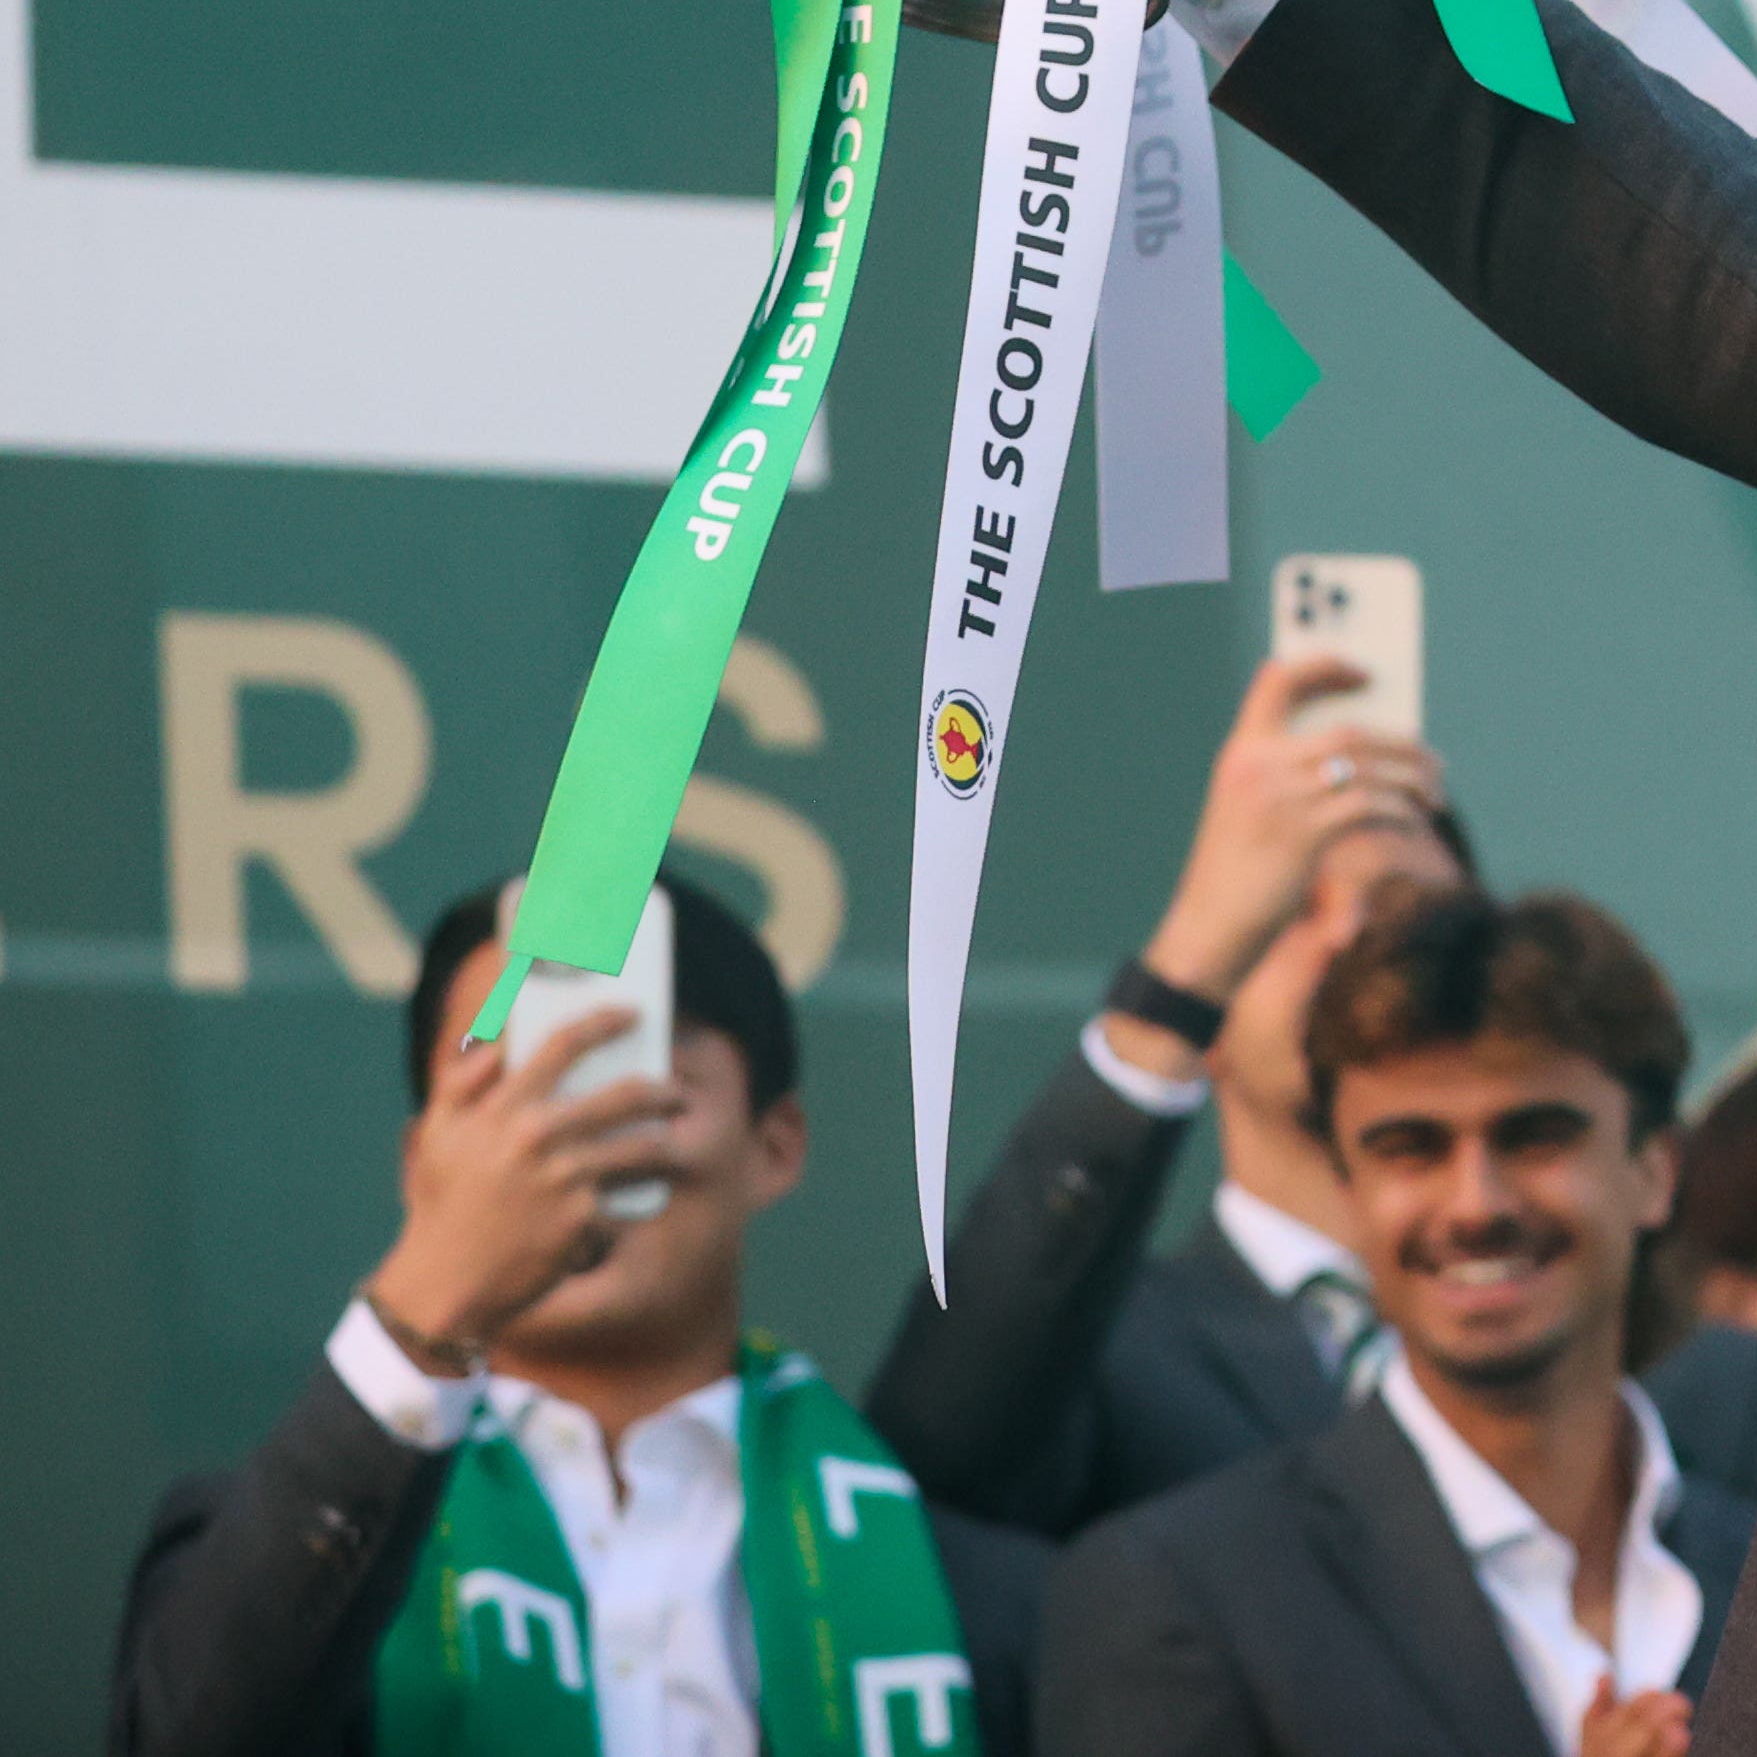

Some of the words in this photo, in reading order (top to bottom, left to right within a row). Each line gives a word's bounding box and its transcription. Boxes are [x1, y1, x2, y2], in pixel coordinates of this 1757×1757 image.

[751, 71, 869, 408] SCOTTISH
[981, 136, 1081, 488] SCOTTISH
[685, 427, 768, 562] CUP
[957, 504, 1016, 643] THE
